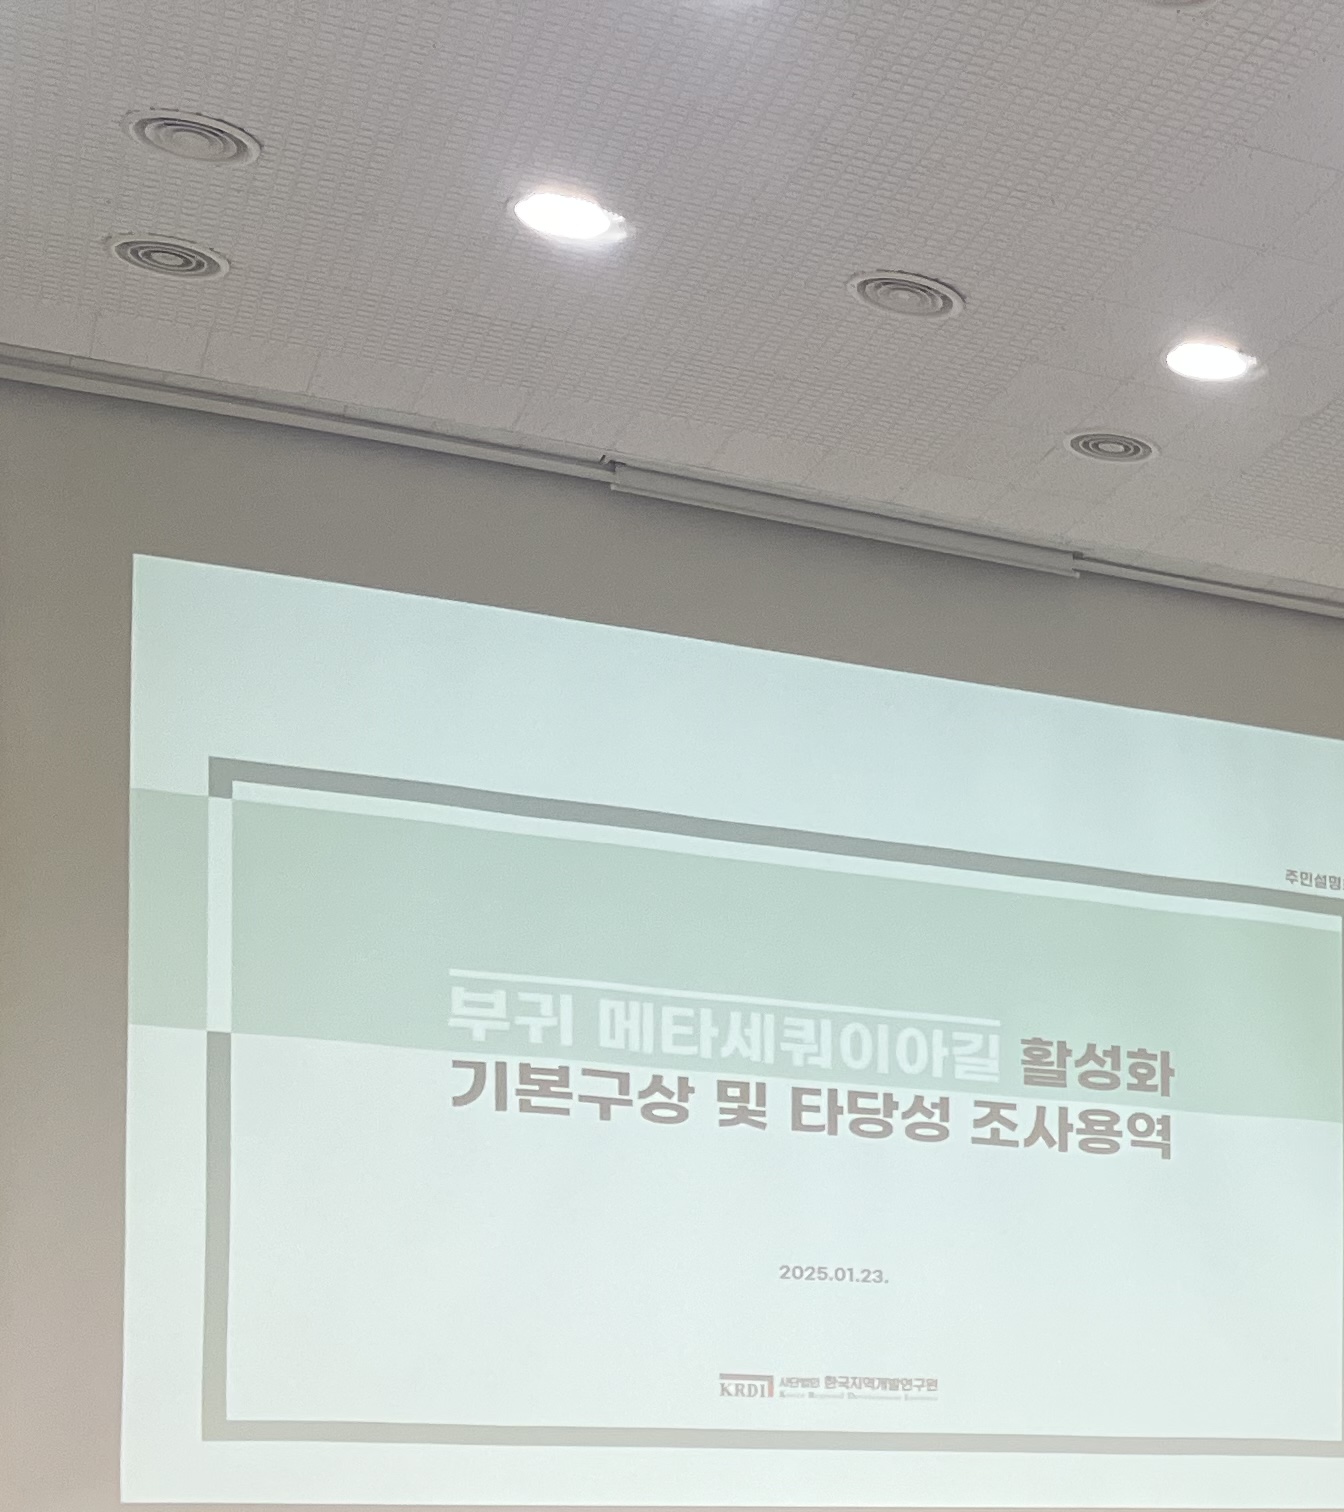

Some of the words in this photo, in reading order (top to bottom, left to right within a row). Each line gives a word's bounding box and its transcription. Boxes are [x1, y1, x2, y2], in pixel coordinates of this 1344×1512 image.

[447, 985, 574, 1047] 부귀
[599, 997, 1000, 1084] 메타세쿼이아길
[1020, 1036, 1176, 1098] 활성화
[451, 1058, 696, 1125] 기본구상
[716, 1079, 768, 1131] 및
[790, 1085, 950, 1144] 타당성
[970, 1098, 1172, 1161] 조사용역
[779, 1264, 889, 1284] 2025.01.23.
[719, 1382, 767, 1399] KRDI
[824, 1375, 939, 1392] 한국지역개발연구원
